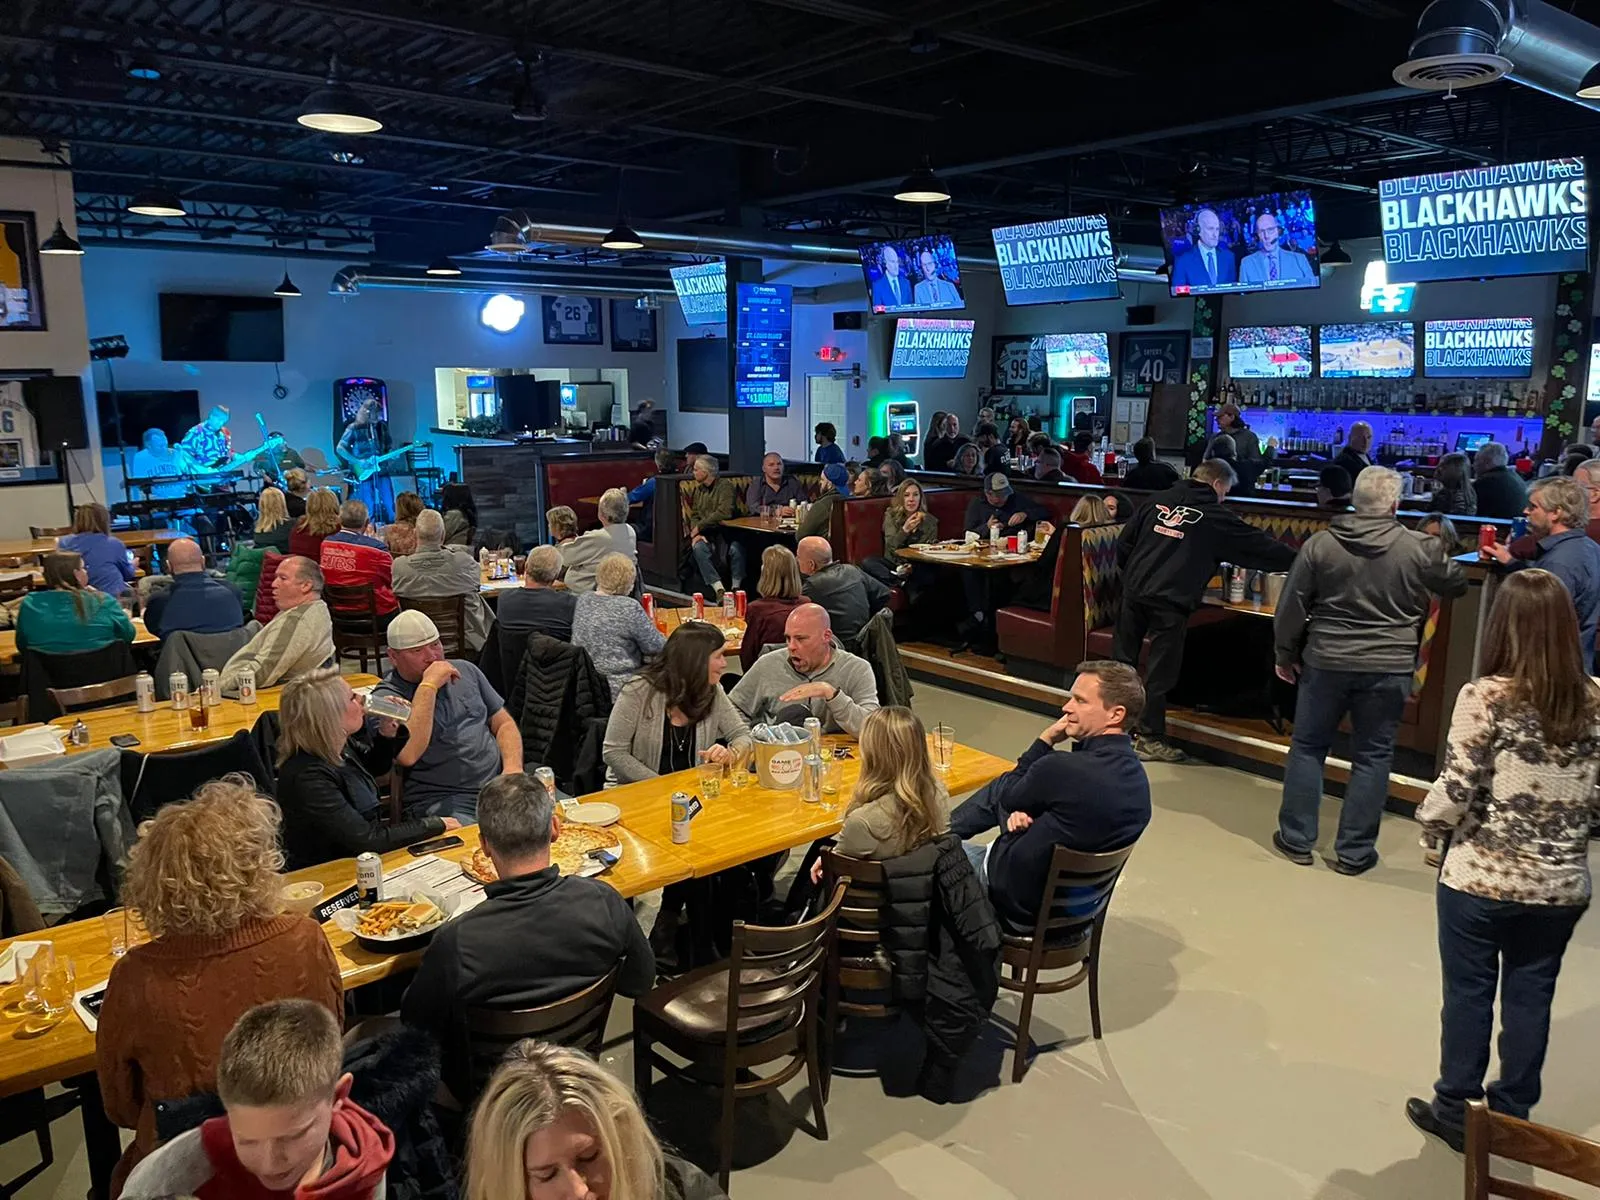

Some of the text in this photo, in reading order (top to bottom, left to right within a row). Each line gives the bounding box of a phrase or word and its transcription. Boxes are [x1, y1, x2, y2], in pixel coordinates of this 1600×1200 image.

[1382, 179, 1586, 231] BLACKHAWKS
[995, 231, 1113, 266] BLACKHAWKS
[1384, 216, 1587, 264] BLACKHAWKS
[1000, 256, 1118, 291] BLACKHAWKS
[673, 274, 727, 297] BLACKHAW
[565, 305, 581, 321] 26
[897, 331, 972, 349] BLACKHAWKS
[1425, 330, 1533, 350] BLACKHAWKS
[894, 349, 969, 367] BLACKHAWKS
[1425, 348, 1532, 367] BLACKHAWKS
[1011, 359, 1027, 380] 99
[1139, 359, 1164, 382] 40
[2, 411, 14, 433] 6
[320, 890, 359, 917] RESERVED
